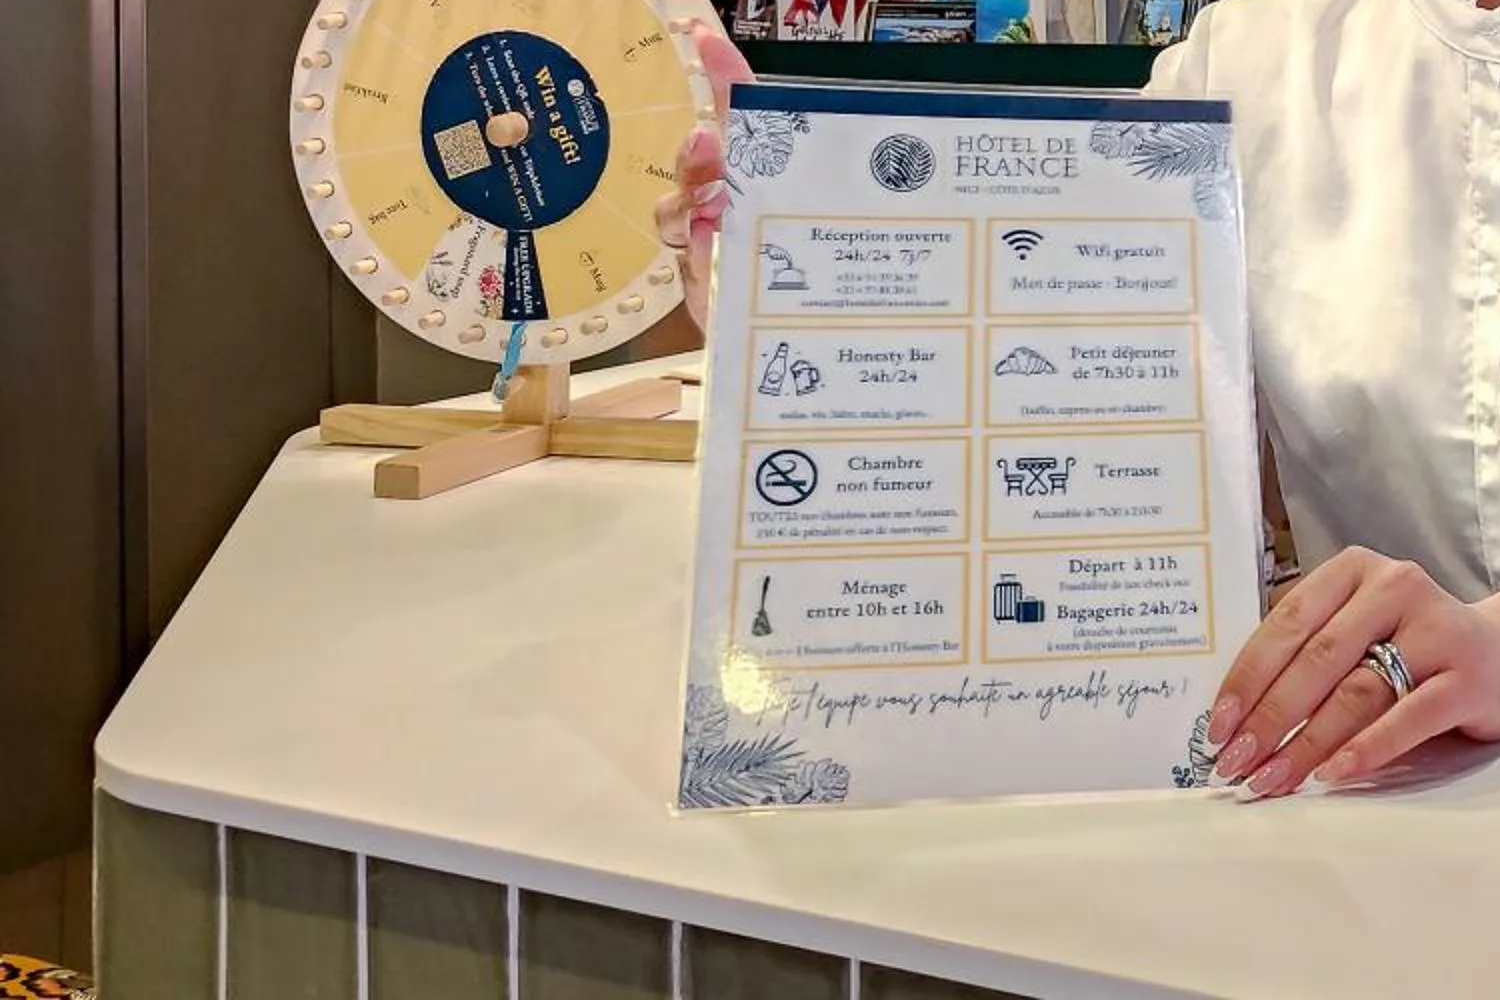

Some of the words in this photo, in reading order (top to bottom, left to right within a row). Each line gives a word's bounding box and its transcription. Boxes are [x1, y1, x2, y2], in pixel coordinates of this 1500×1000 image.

[535, 65, 557, 109] Win
[549, 111, 561, 123] a
[549, 125, 581, 165] gift!
[956, 133, 1037, 153] HÔTEL
[1047, 137, 1077, 155] DE
[955, 155, 1080, 178] FRANCE
[811, 228, 890, 246] Réception
[894, 231, 952, 244] ouverte
[834, 249, 891, 262] 24h/24
[900, 249, 932, 265] 7j/7
[1075, 244, 1111, 258] Wifi
[1115, 246, 1166, 260] gratuit
[1047, 277, 1064, 290] de
[838, 348, 903, 366] Honesty
[909, 347, 937, 362] Bar
[1071, 346, 1107, 360] Petit
[1112, 344, 1176, 362] déjeuner
[859, 369, 918, 383] 24h/24
[1072, 367, 1090, 380] de
[1094, 366, 1134, 380] 7h30
[1151, 365, 1179, 380] 11h
[848, 455, 924, 471] Chambre
[1094, 462, 1161, 478] Terrasse
[836, 481, 868, 493] non
[873, 477, 933, 491] fumeur
[1069, 559, 1125, 577] Départ
[1134, 557, 1142, 571] à
[1149, 556, 1178, 570] 11h
[841, 580, 907, 598] Ménage
[806, 604, 850, 619] entre
[856, 602, 887, 617] 10h
[892, 602, 907, 615] et
[914, 599, 944, 616] 16h
[1057, 604, 1135, 623] Bagagerie
[1140, 600, 1199, 617] 24h/24
[875, 692, 923, 715] vous
